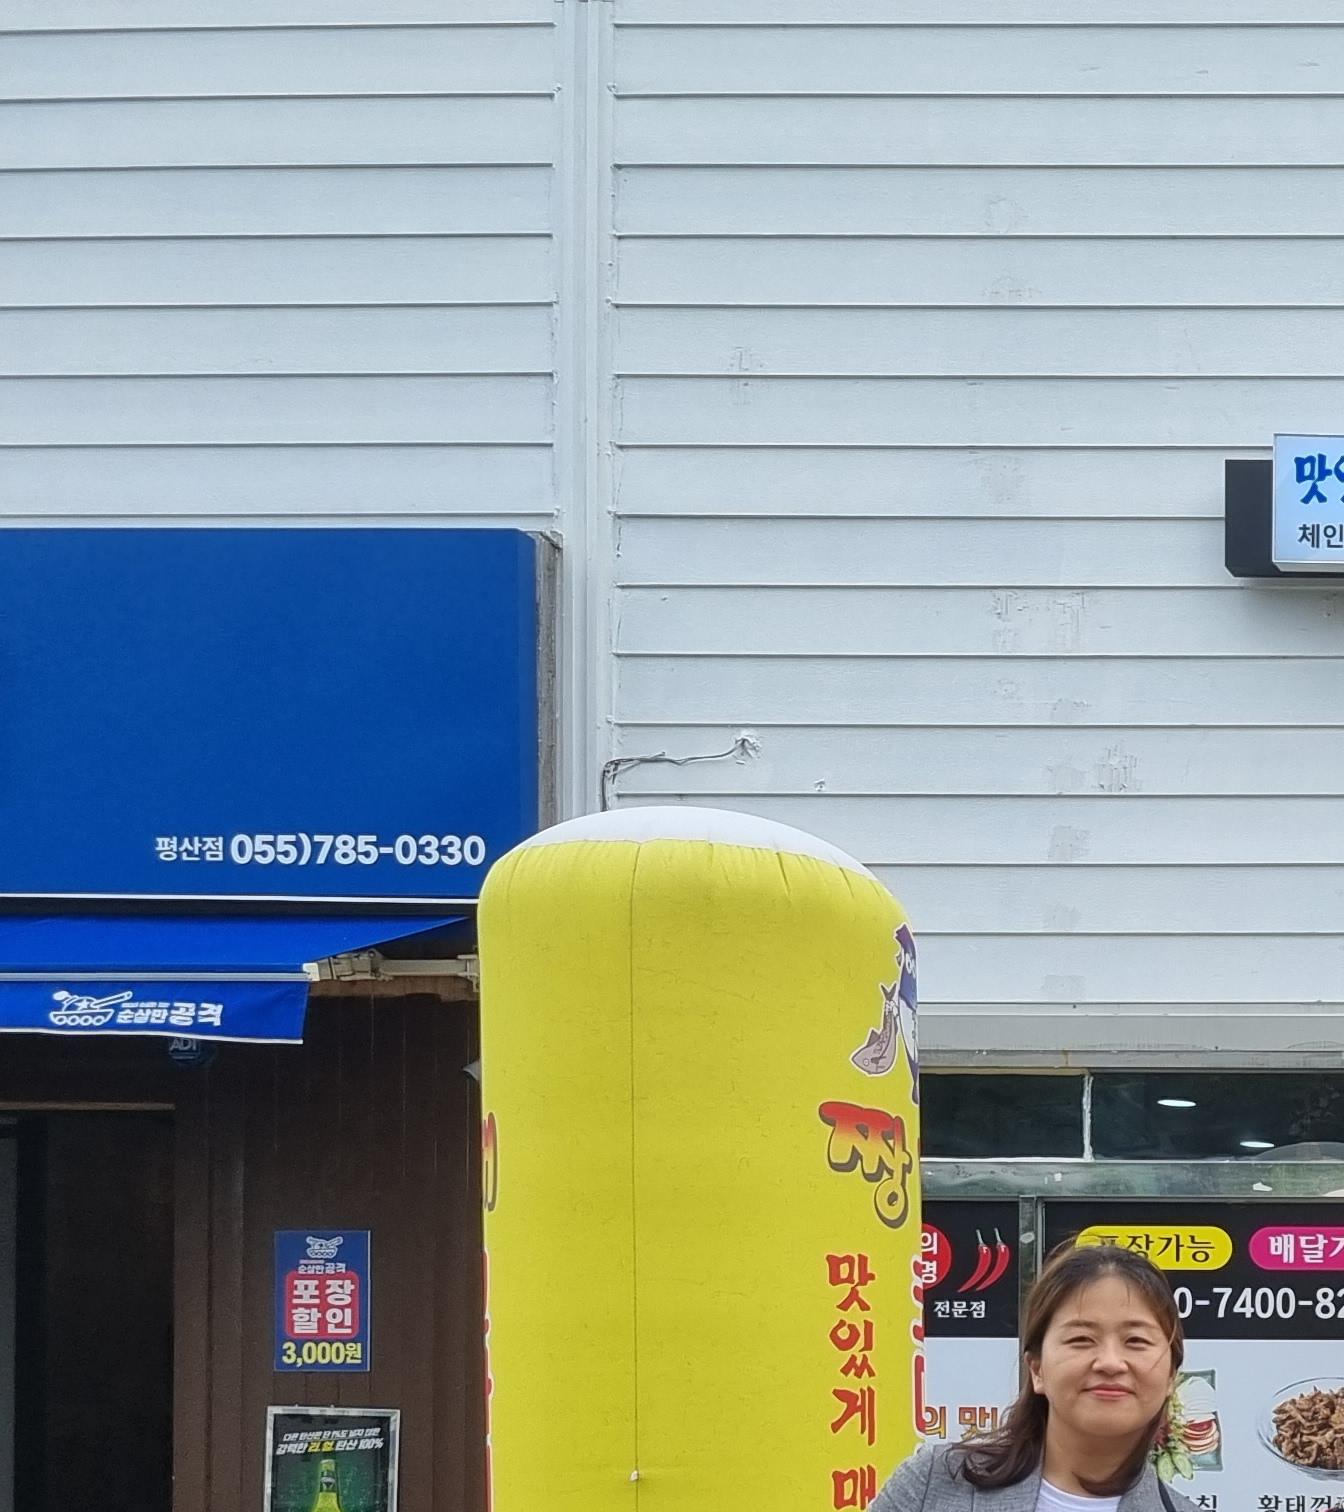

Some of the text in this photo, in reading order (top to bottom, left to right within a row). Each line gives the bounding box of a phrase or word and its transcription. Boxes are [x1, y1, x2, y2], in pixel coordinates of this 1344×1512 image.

[155, 833, 486, 865] 평산점 055)785-0330
[819, 1101, 912, 1229] 짱
[291, 1279, 356, 1306] 포장
[290, 1307, 354, 1334] 할인
[933, 1300, 987, 1319] 전문점
[282, 1341, 363, 1368] 3,000원
